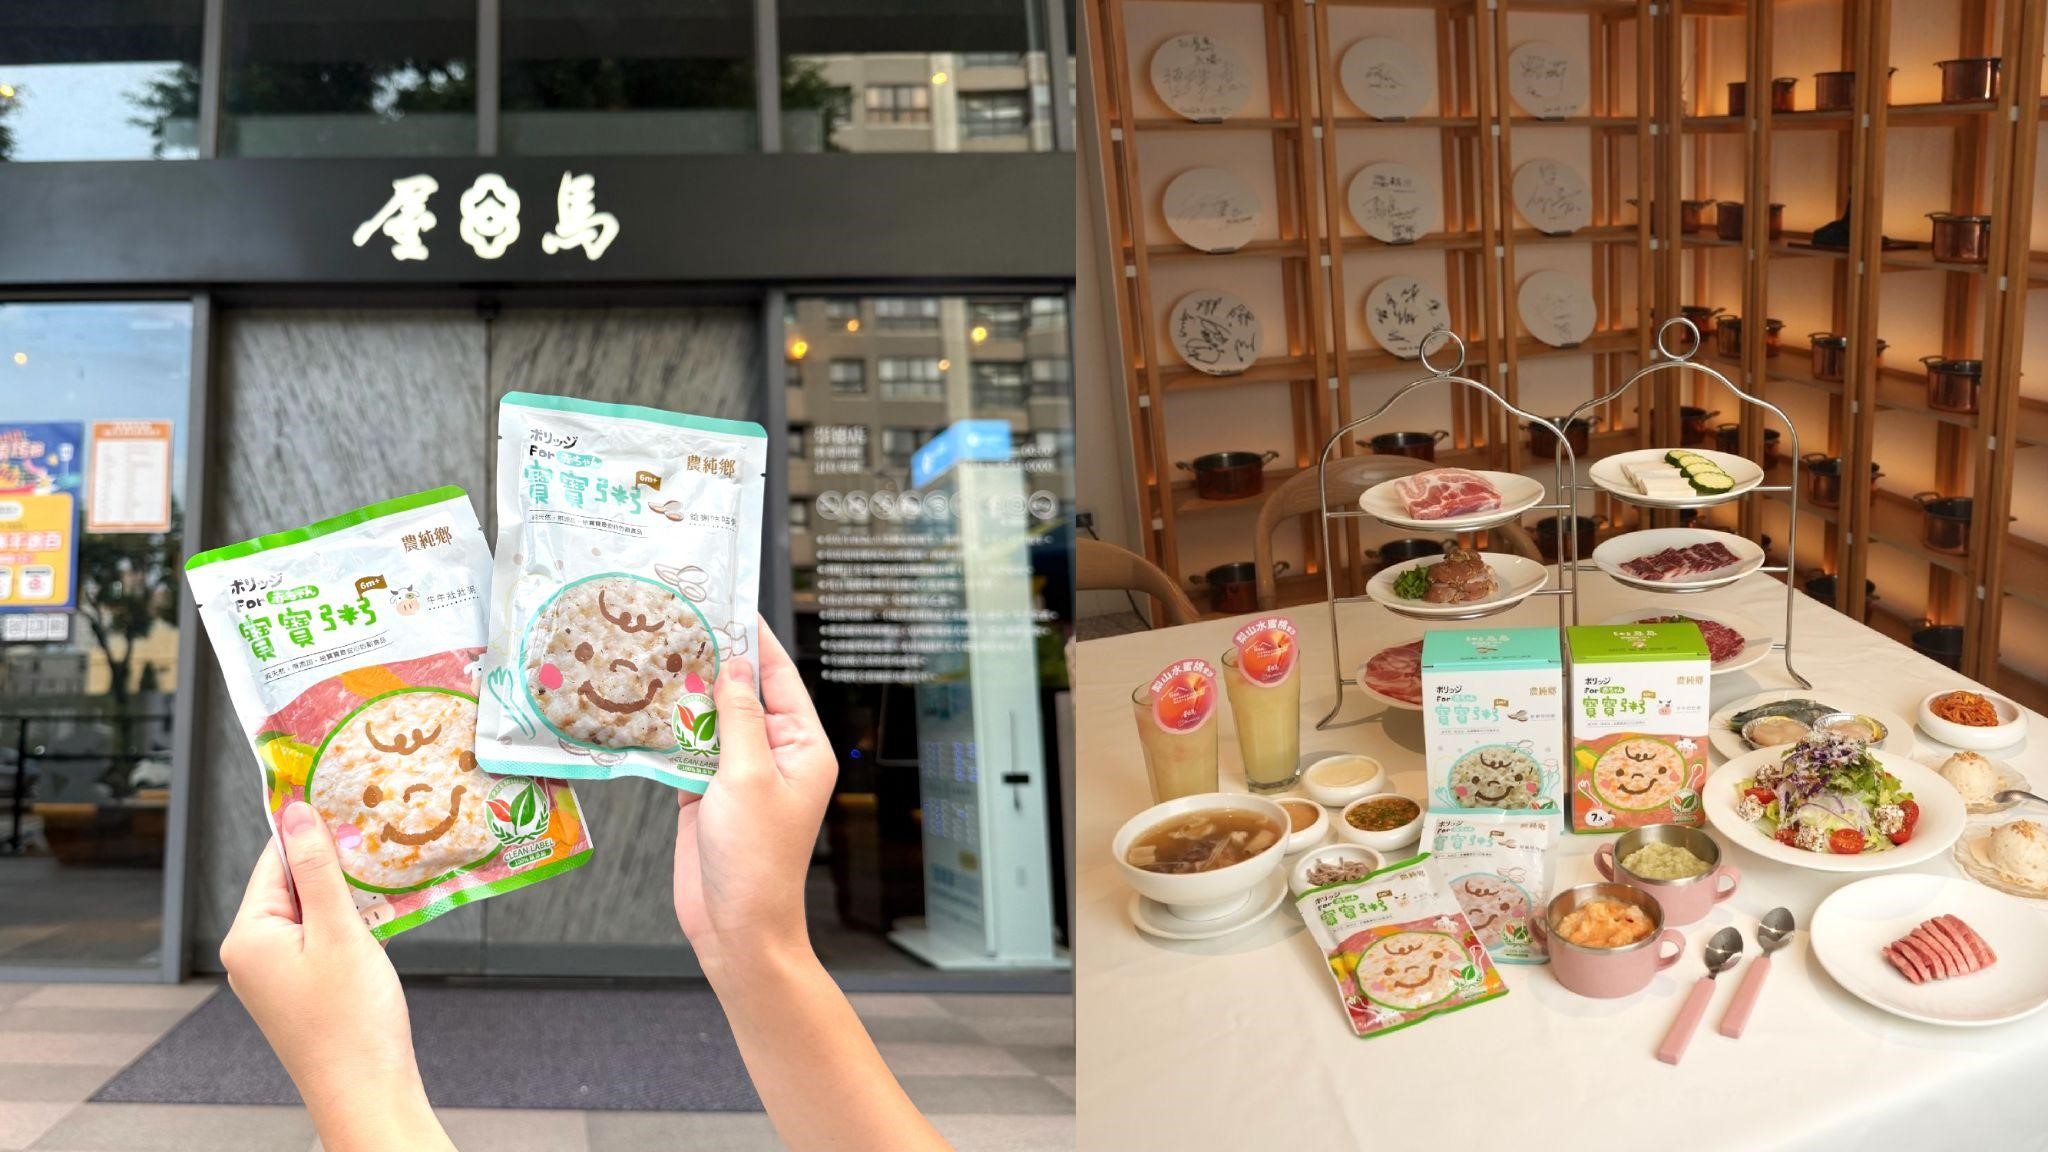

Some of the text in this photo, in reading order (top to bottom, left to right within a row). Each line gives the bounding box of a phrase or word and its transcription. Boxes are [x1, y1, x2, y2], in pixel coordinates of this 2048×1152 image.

[352, 170, 620, 261] 屋 馬
[530, 428, 578, 449] ポリッジ
[529, 445, 555, 459] For
[639, 474, 657, 484] 6m+
[402, 526, 452, 553] 農純鄉
[231, 573, 282, 595] ポリッジ
[360, 578, 380, 590] 6m+
[235, 598, 265, 613] For
[238, 596, 377, 662] 寶寶粥
[1436, 695, 1451, 703] For
[504, 839, 554, 861] CLEAN LABEL
